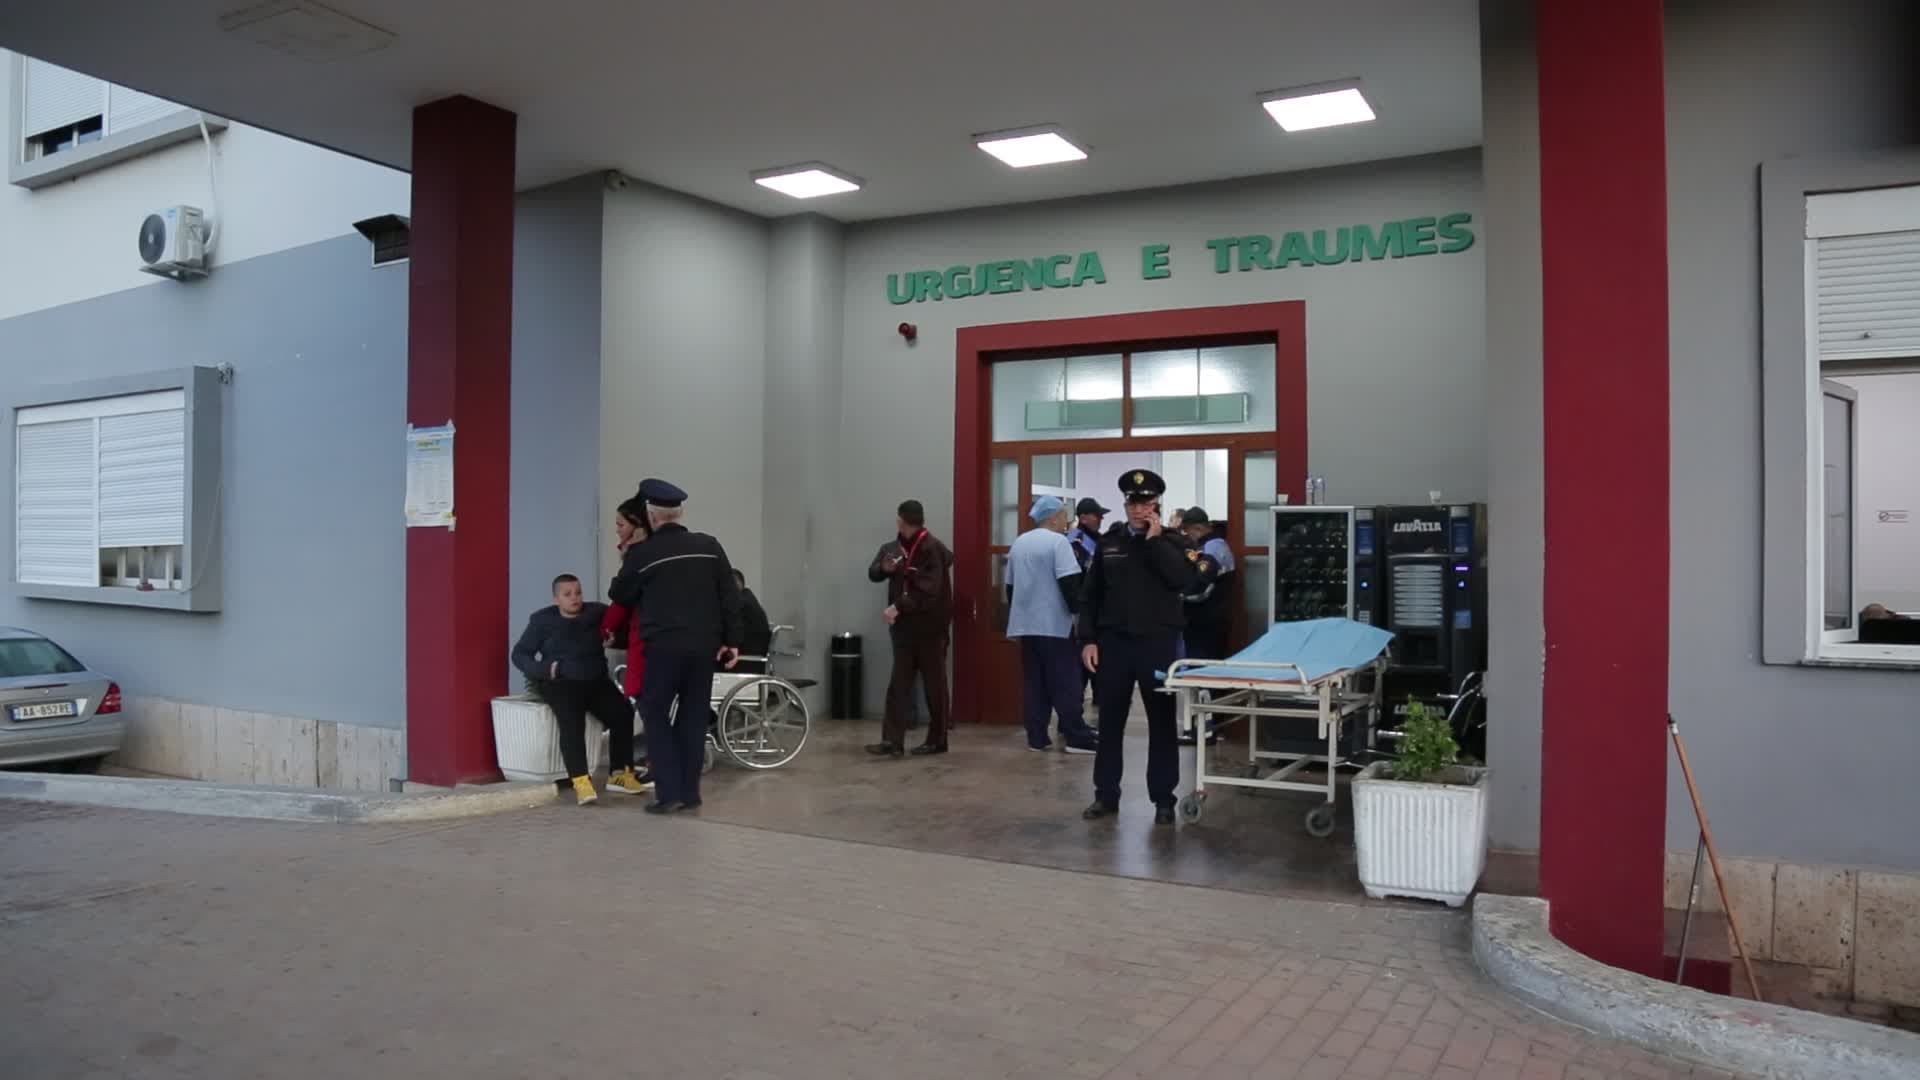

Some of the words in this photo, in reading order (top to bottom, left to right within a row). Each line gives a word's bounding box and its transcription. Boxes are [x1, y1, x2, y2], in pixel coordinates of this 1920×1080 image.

[887, 252, 1106, 304] URGJENCA
[1141, 244, 1171, 280] E
[1206, 213, 1474, 273] TRAUMES
